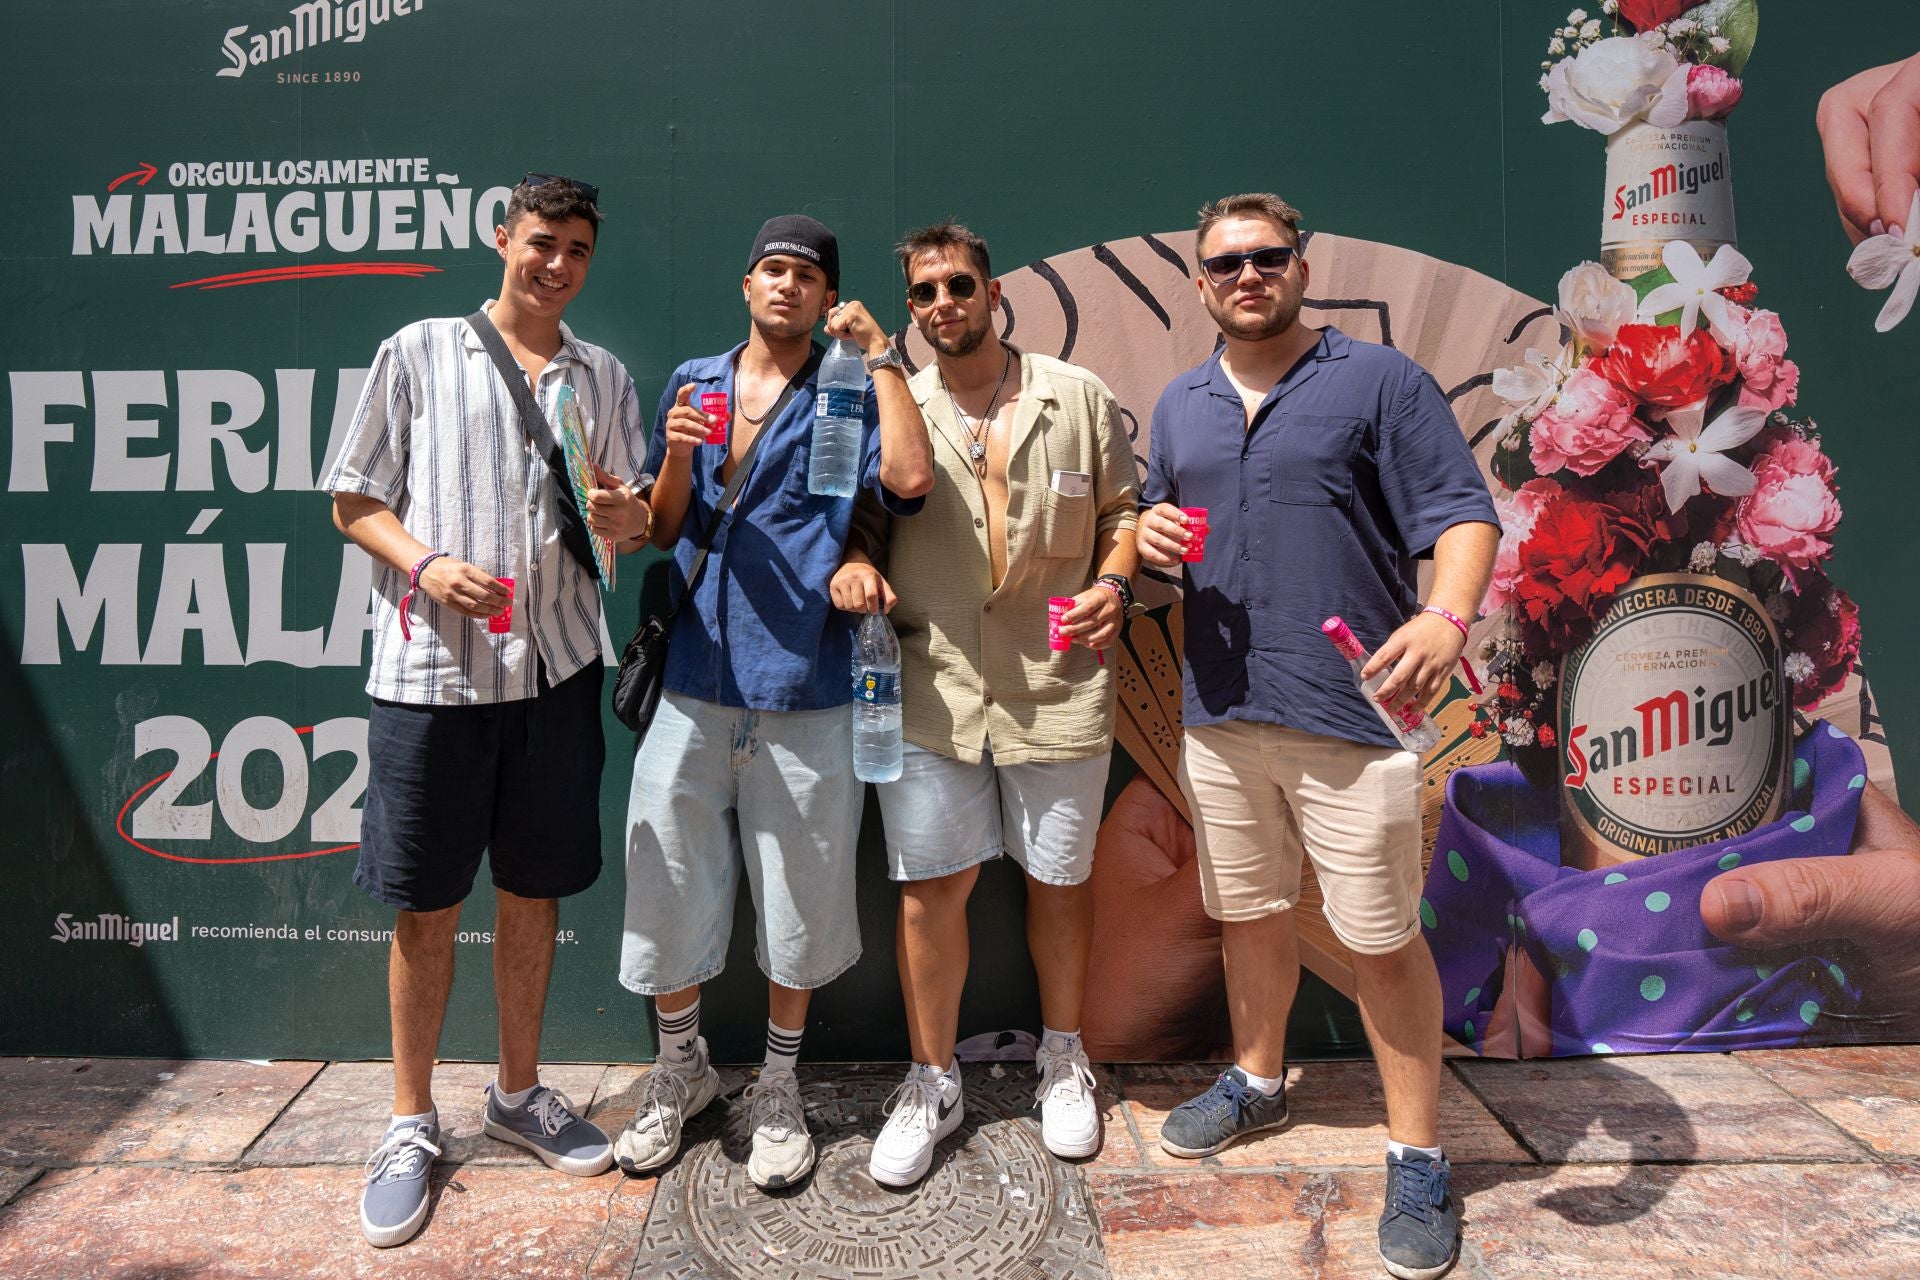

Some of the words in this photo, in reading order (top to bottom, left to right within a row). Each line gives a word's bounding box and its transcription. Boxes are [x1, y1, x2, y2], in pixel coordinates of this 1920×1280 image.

[324, 71, 361, 82] 1890
[1670, 133, 1711, 145] PREMIUM
[168, 158, 430, 187] ORGULLOSAMENTE
[72, 173, 513, 256] MALAGUEÑO
[1632, 211, 1707, 226] ESPECIAL
[1674, 616, 1713, 637] THE
[1684, 588, 1737, 616] DESDE
[1738, 607, 1767, 644] 1890
[1616, 651, 1671, 662] CERVEZA
[1676, 647, 1729, 659] PREMIUM
[1623, 659, 1721, 673] INTERNACIONAL
[132, 715, 370, 843] 202
[1612, 774, 1736, 796] ESPECIAL
[1596, 816, 1722, 857] ORIGINALMENTE
[1726, 783, 1775, 839] NATURAL
[191, 924, 299, 940] recomienda
[304, 925, 321, 940] el
[326, 928, 396, 943] consum
